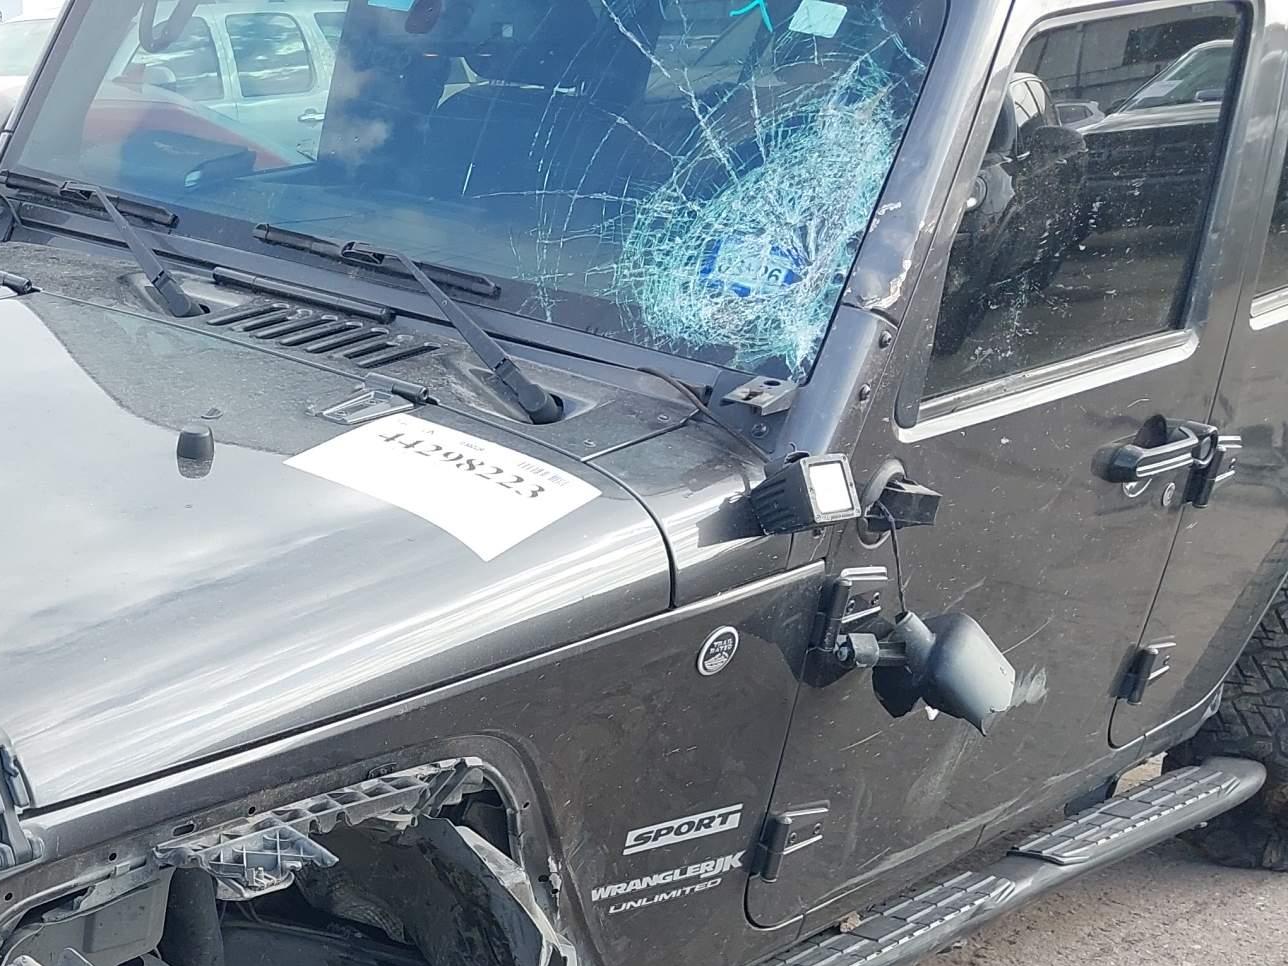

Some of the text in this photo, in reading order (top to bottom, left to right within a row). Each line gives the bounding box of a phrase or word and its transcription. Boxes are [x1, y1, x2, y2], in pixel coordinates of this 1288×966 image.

[378, 432, 546, 499] 44298223
[630, 812, 734, 847] SPORT
[608, 877, 722, 915] UNLIMITED
